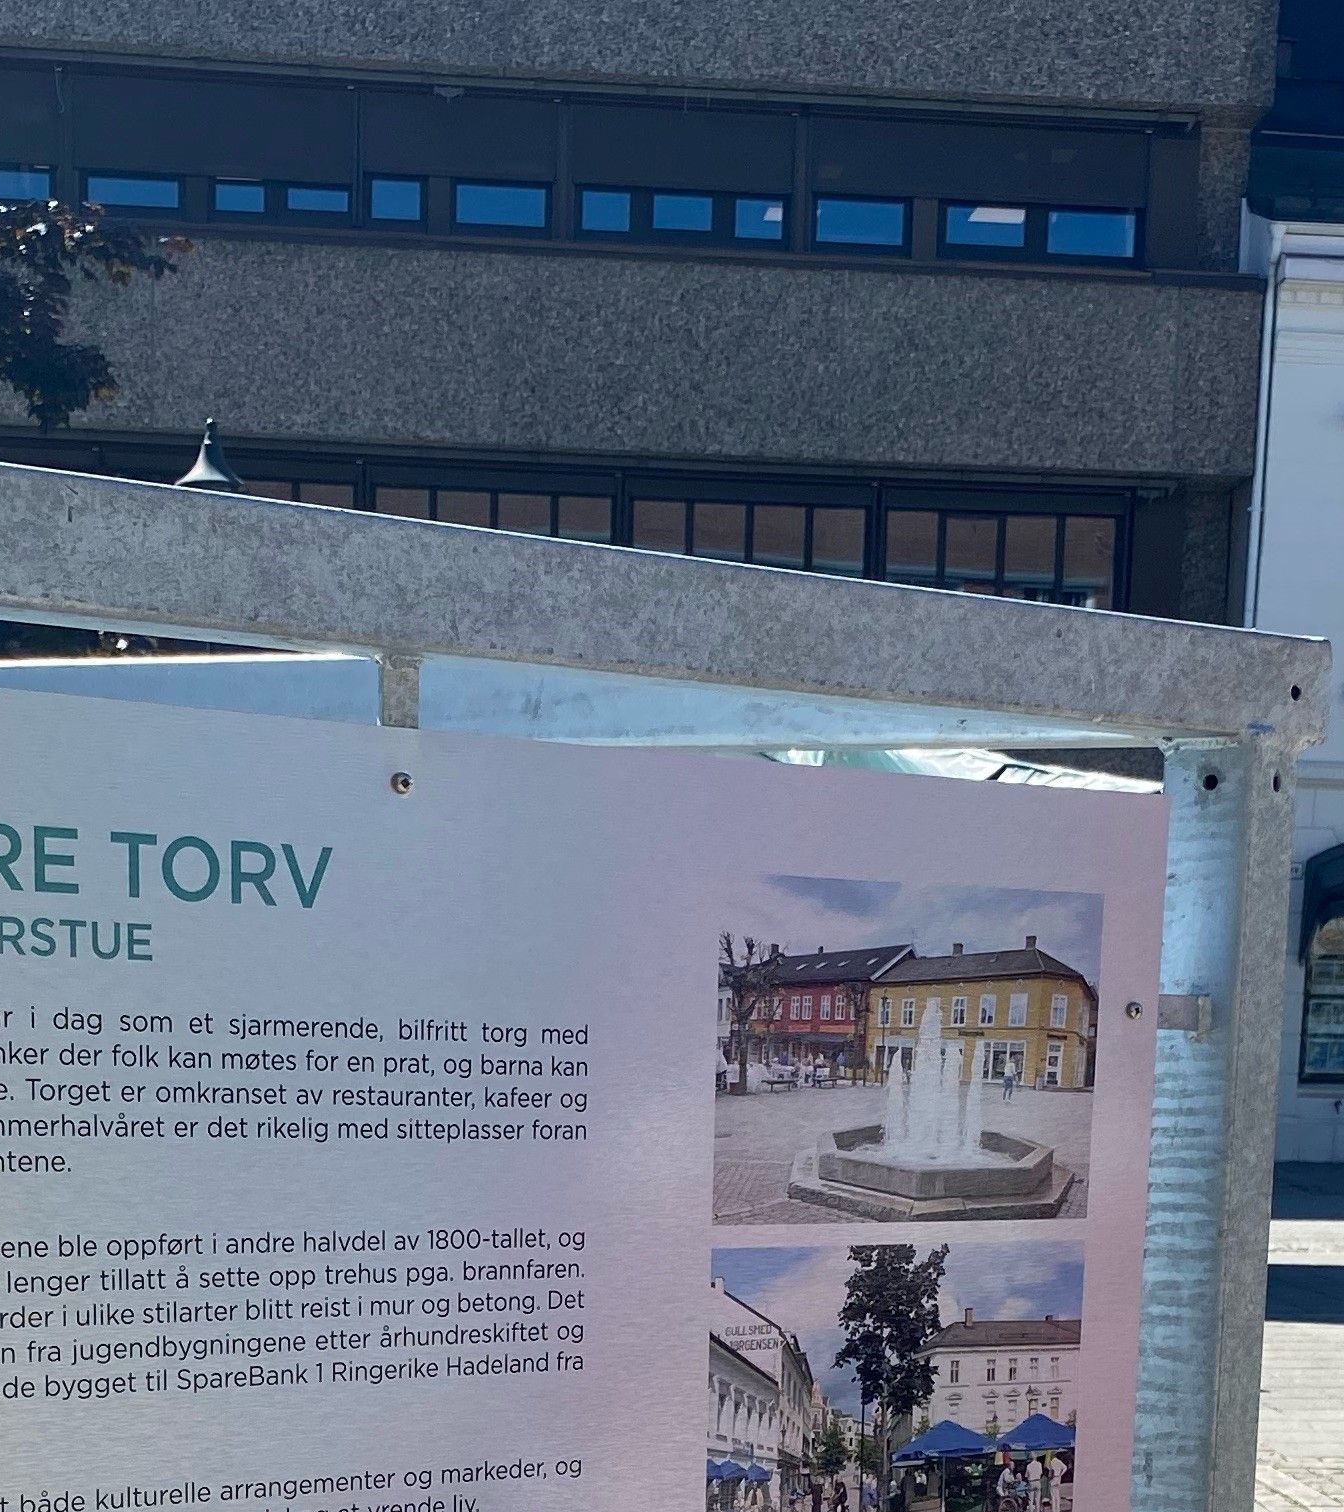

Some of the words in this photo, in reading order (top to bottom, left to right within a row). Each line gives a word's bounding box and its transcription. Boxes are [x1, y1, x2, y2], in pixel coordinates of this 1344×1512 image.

[110, 830, 334, 910] TORV
[30, 1005, 35, 1029] i
[52, 1006, 103, 1036] dag
[119, 1014, 173, 1033] som
[189, 1012, 214, 1035] et
[228, 1013, 384, 1043] sjarmerende,
[398, 1017, 468, 1043] bilfritt
[481, 1022, 528, 1048] torg
[541, 1023, 589, 1046] med
[58, 1042, 103, 1067] der
[111, 1043, 159, 1068] folk
[168, 1045, 212, 1069] kan
[221, 1049, 297, 1071] møtes
[305, 1048, 340, 1072] for
[347, 1055, 375, 1073] en
[383, 1053, 435, 1078] prat,
[443, 1057, 472, 1079] og
[480, 1053, 543, 1077] barna
[551, 1055, 588, 1077] kan
[24, 1078, 111, 1107] Torget
[120, 1085, 147, 1103] er
[155, 1080, 288, 1105] omkranset
[296, 1088, 324, 1106] av
[332, 1085, 476, 1111] restauranter,
[484, 1085, 553, 1109] kafeer
[560, 1092, 588, 1113] og
[174, 1120, 200, 1138] er
[207, 1115, 249, 1139] det
[257, 1116, 329, 1144] rikelig
[337, 1117, 389, 1140] med
[396, 1117, 525, 1144] sitteplasser
[531, 1118, 587, 1141] foran
[58, 1234, 98, 1258] ble
[106, 1232, 204, 1261] oppført
[212, 1232, 217, 1255] i
[225, 1231, 295, 1255] andre
[303, 1229, 386, 1253] halvdel
[393, 1234, 420, 1251] av
[426, 1227, 551, 1251] 1800-tallet,
[558, 1231, 586, 1252] og
[7, 1270, 91, 1297] lenger
[99, 1267, 167, 1291] tillatt
[175, 1264, 189, 1289] å
[199, 1266, 260, 1289] sette
[269, 1269, 316, 1291] opp
[324, 1262, 398, 1285] trehus
[406, 1266, 454, 1288] pga.
[462, 1258, 585, 1281] brannfaren.
[45, 1371, 137, 1401] bygget
[145, 1368, 168, 1392] til
[176, 1362, 309, 1394] SpareBank
[315, 1362, 323, 1383] 1
[332, 1357, 439, 1385] Ringerike
[446, 1351, 549, 1377] Hadeland
[556, 1350, 584, 1372] fra
[95, 1481, 211, 1511] kulturelle
[220, 1470, 396, 1501] arrangementer
[403, 1470, 432, 1490] og
[441, 1457, 547, 1485] markeder,
[555, 1459, 582, 1479] og
